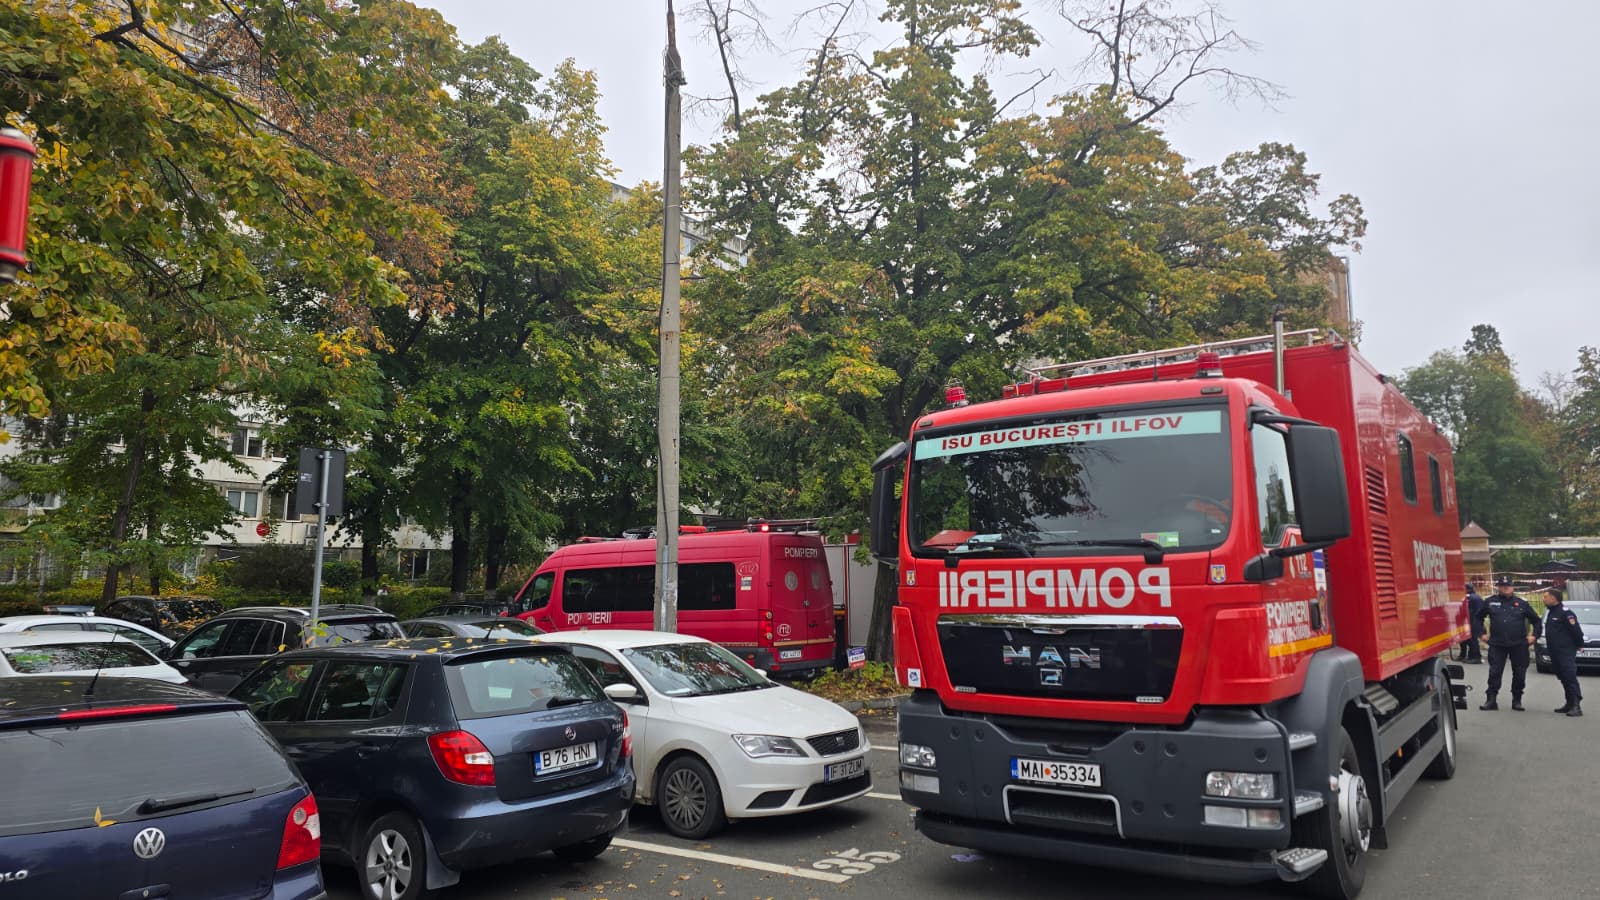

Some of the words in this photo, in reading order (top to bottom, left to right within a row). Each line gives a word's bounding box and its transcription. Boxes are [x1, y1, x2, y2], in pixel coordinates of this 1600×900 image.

[941, 435, 973, 451] ISU
[1111, 415, 1184, 433] ILFOV
[1002, 645, 1101, 669] MAN
[543, 752, 552, 768] B
[554, 749, 569, 765] 76
[573, 743, 591, 761] HNI
[1021, 761, 1044, 779] MAI
[1050, 764, 1097, 783] 35334
[812, 847, 902, 875] 35
